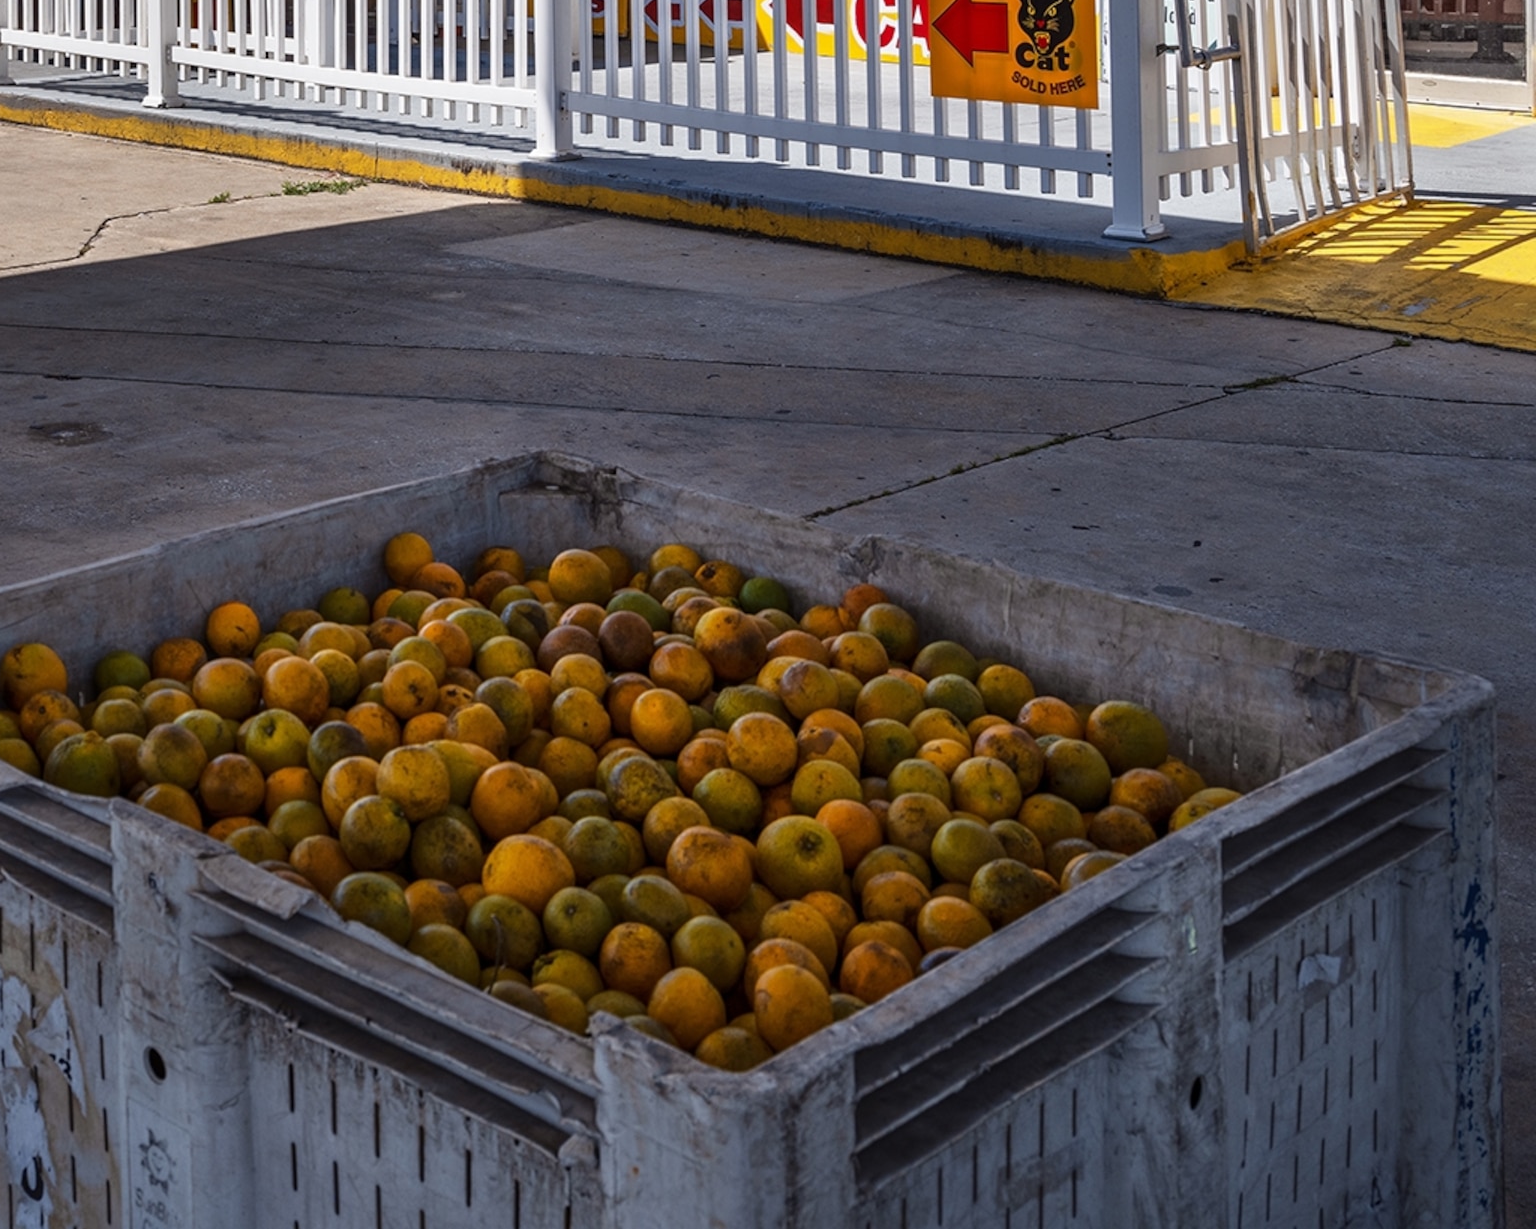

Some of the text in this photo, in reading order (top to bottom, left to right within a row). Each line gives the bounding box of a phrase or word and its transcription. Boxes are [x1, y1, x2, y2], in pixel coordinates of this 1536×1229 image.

[1015, 41, 1070, 72] Cat
[1011, 70, 1087, 96] SOLD HERE
